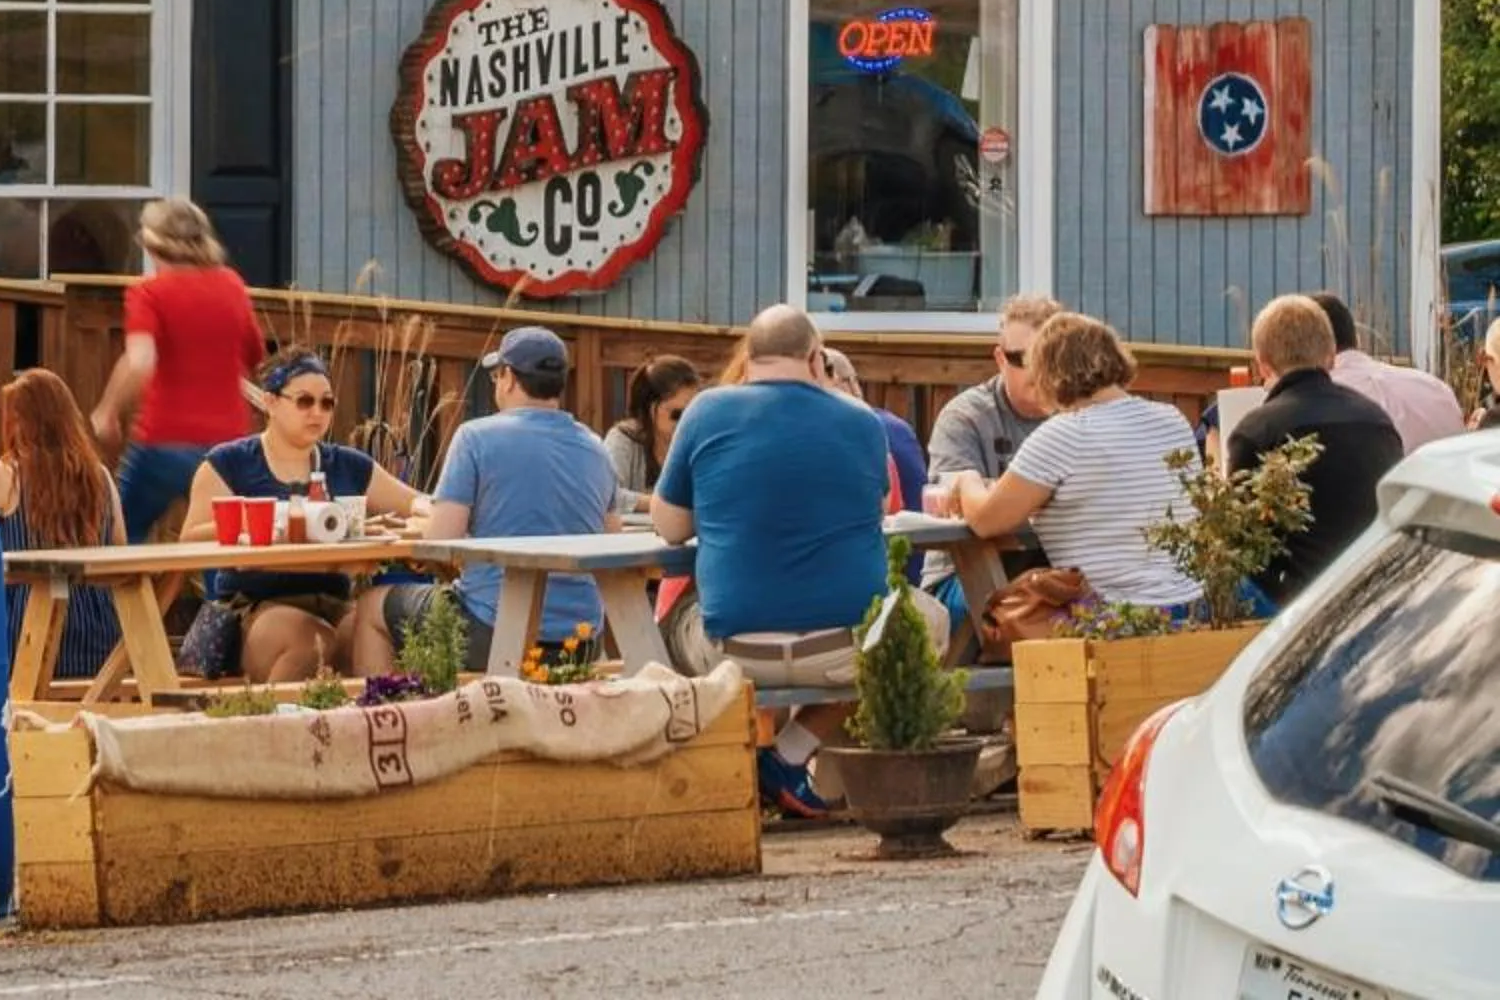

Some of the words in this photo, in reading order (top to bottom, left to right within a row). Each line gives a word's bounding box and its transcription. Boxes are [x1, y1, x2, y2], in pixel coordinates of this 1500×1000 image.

[478, 7, 549, 47] THE
[838, 20, 935, 56] OPEN
[439, 15, 630, 107] NASHVILLE
[431, 66, 678, 201] JAM
